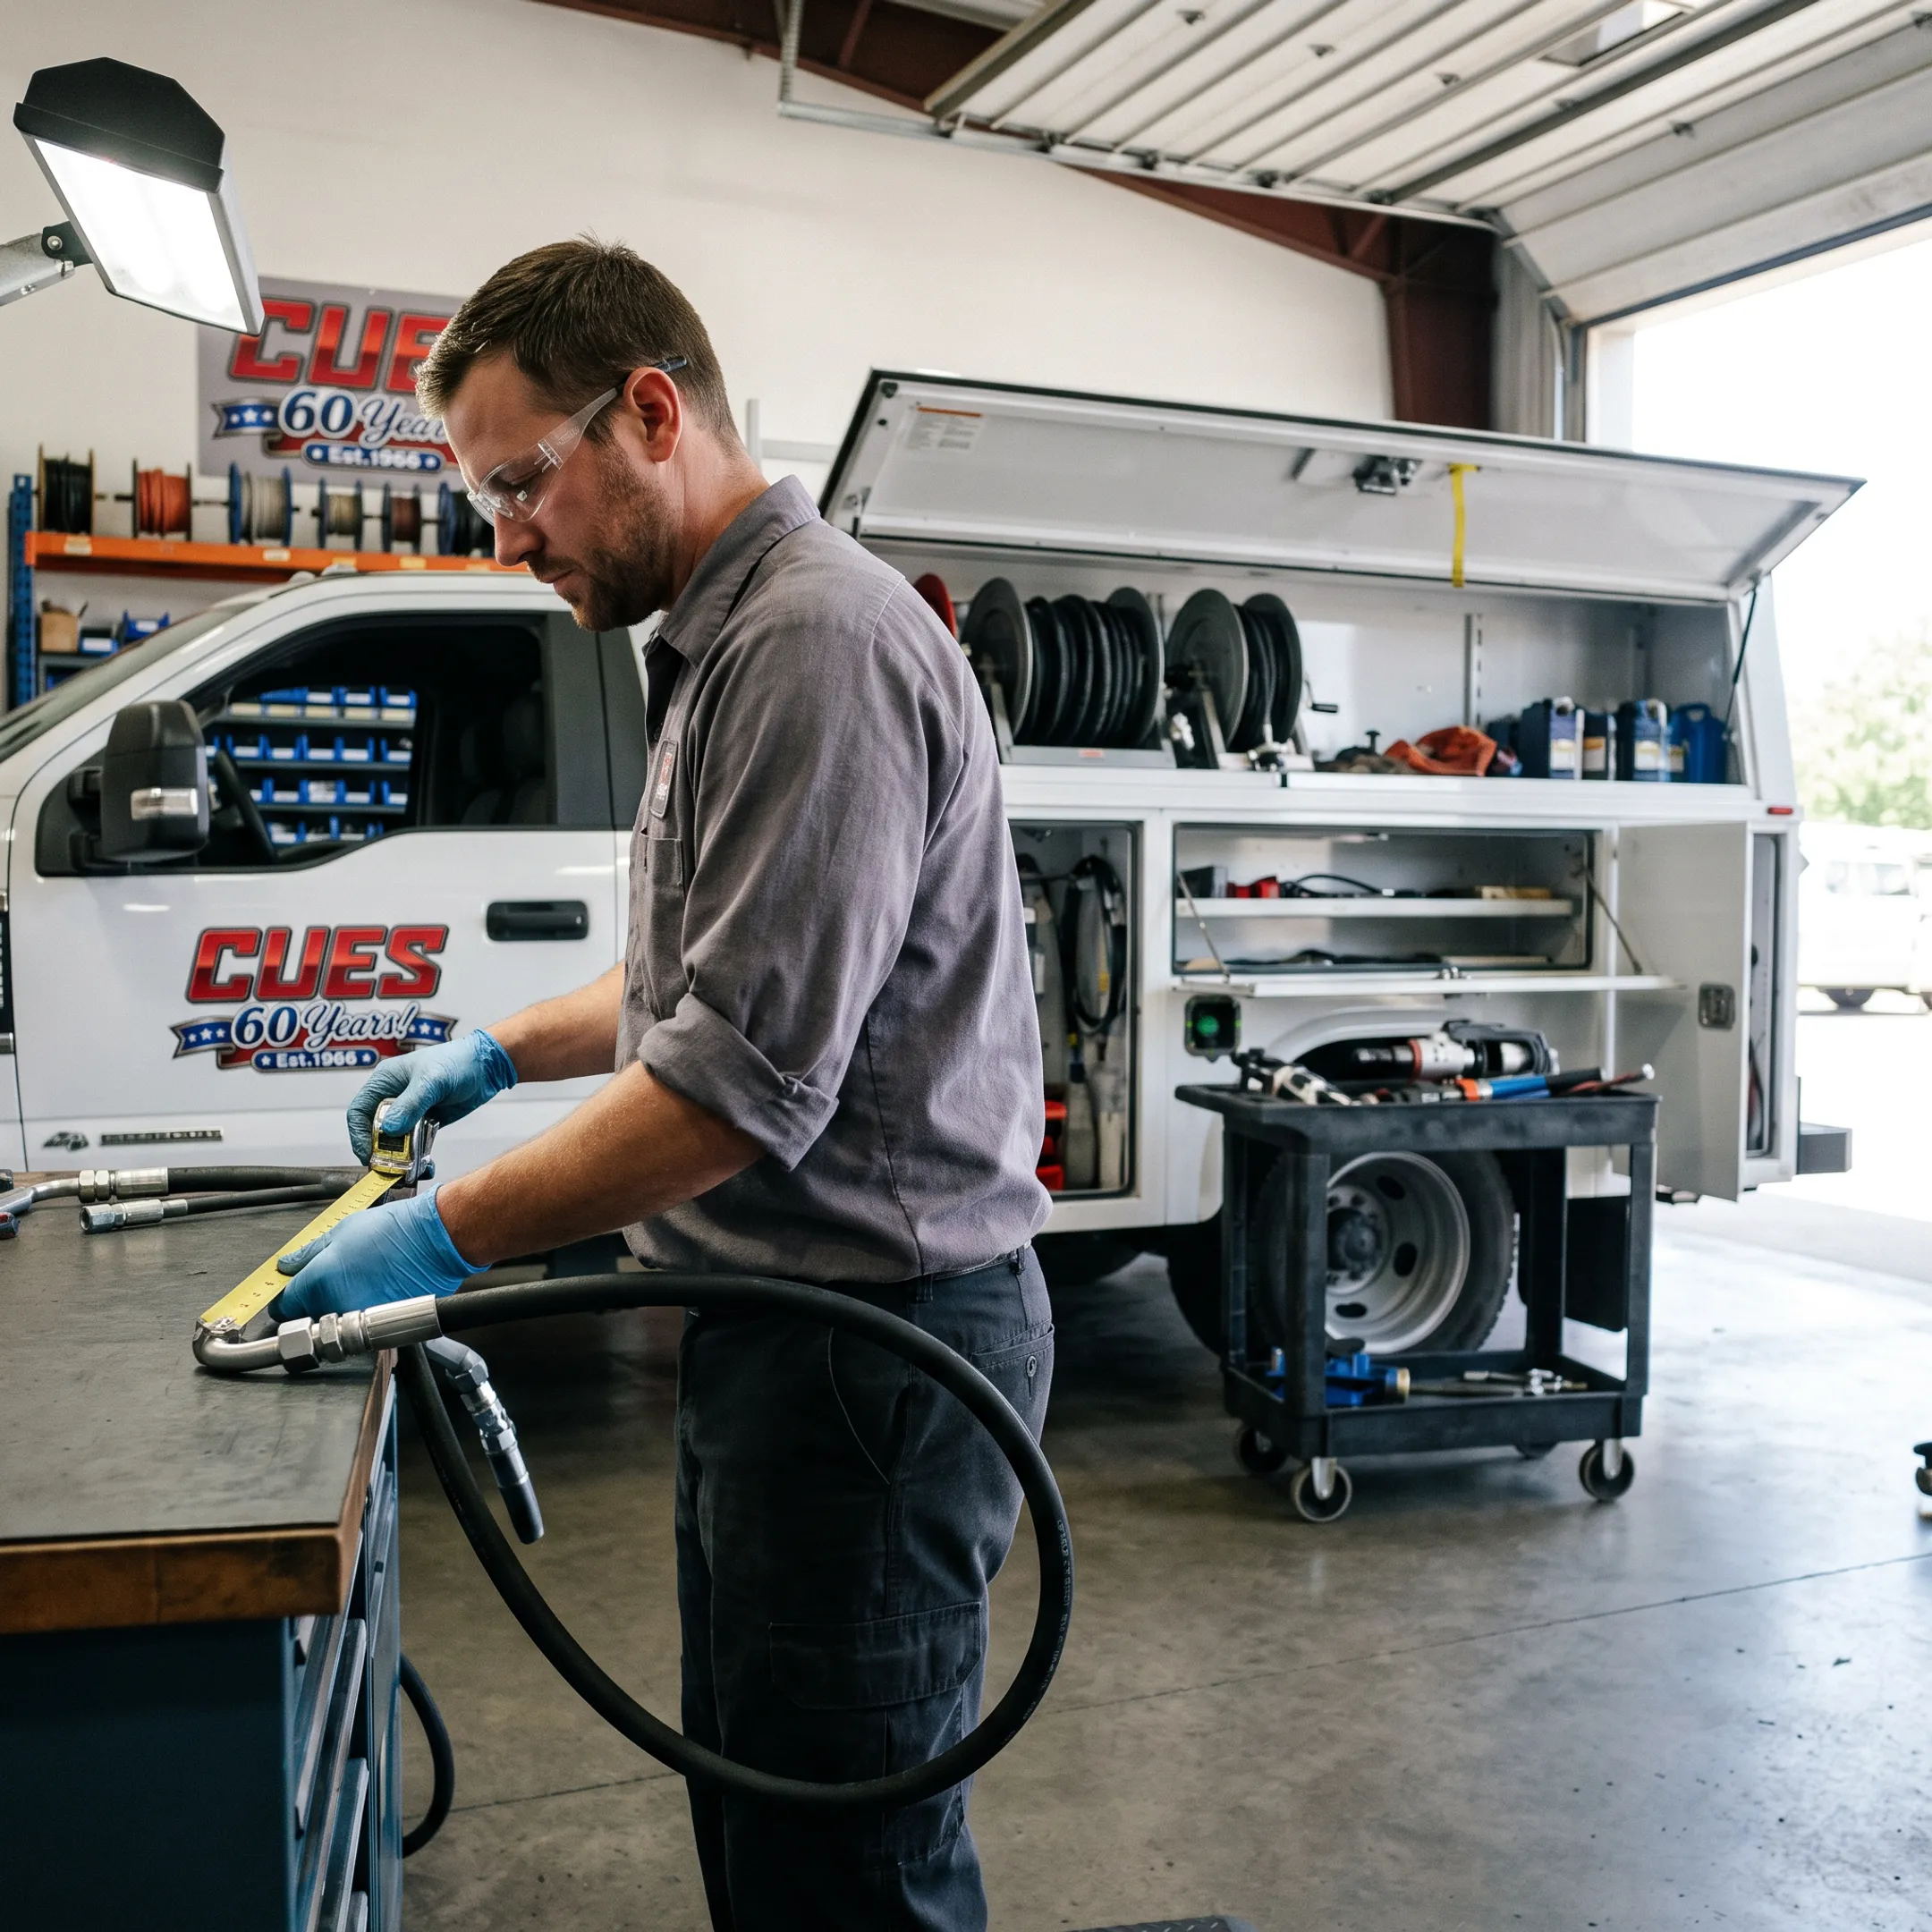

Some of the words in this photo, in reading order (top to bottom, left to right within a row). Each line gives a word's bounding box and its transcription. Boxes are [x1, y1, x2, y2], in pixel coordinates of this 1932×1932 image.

[281, 388, 357, 436] 60
[186, 925, 449, 1002] CUES
[233, 1003, 300, 1046] 60
[302, 1001, 419, 1050] Years!
[275, 1050, 358, 1068] Est.1966
